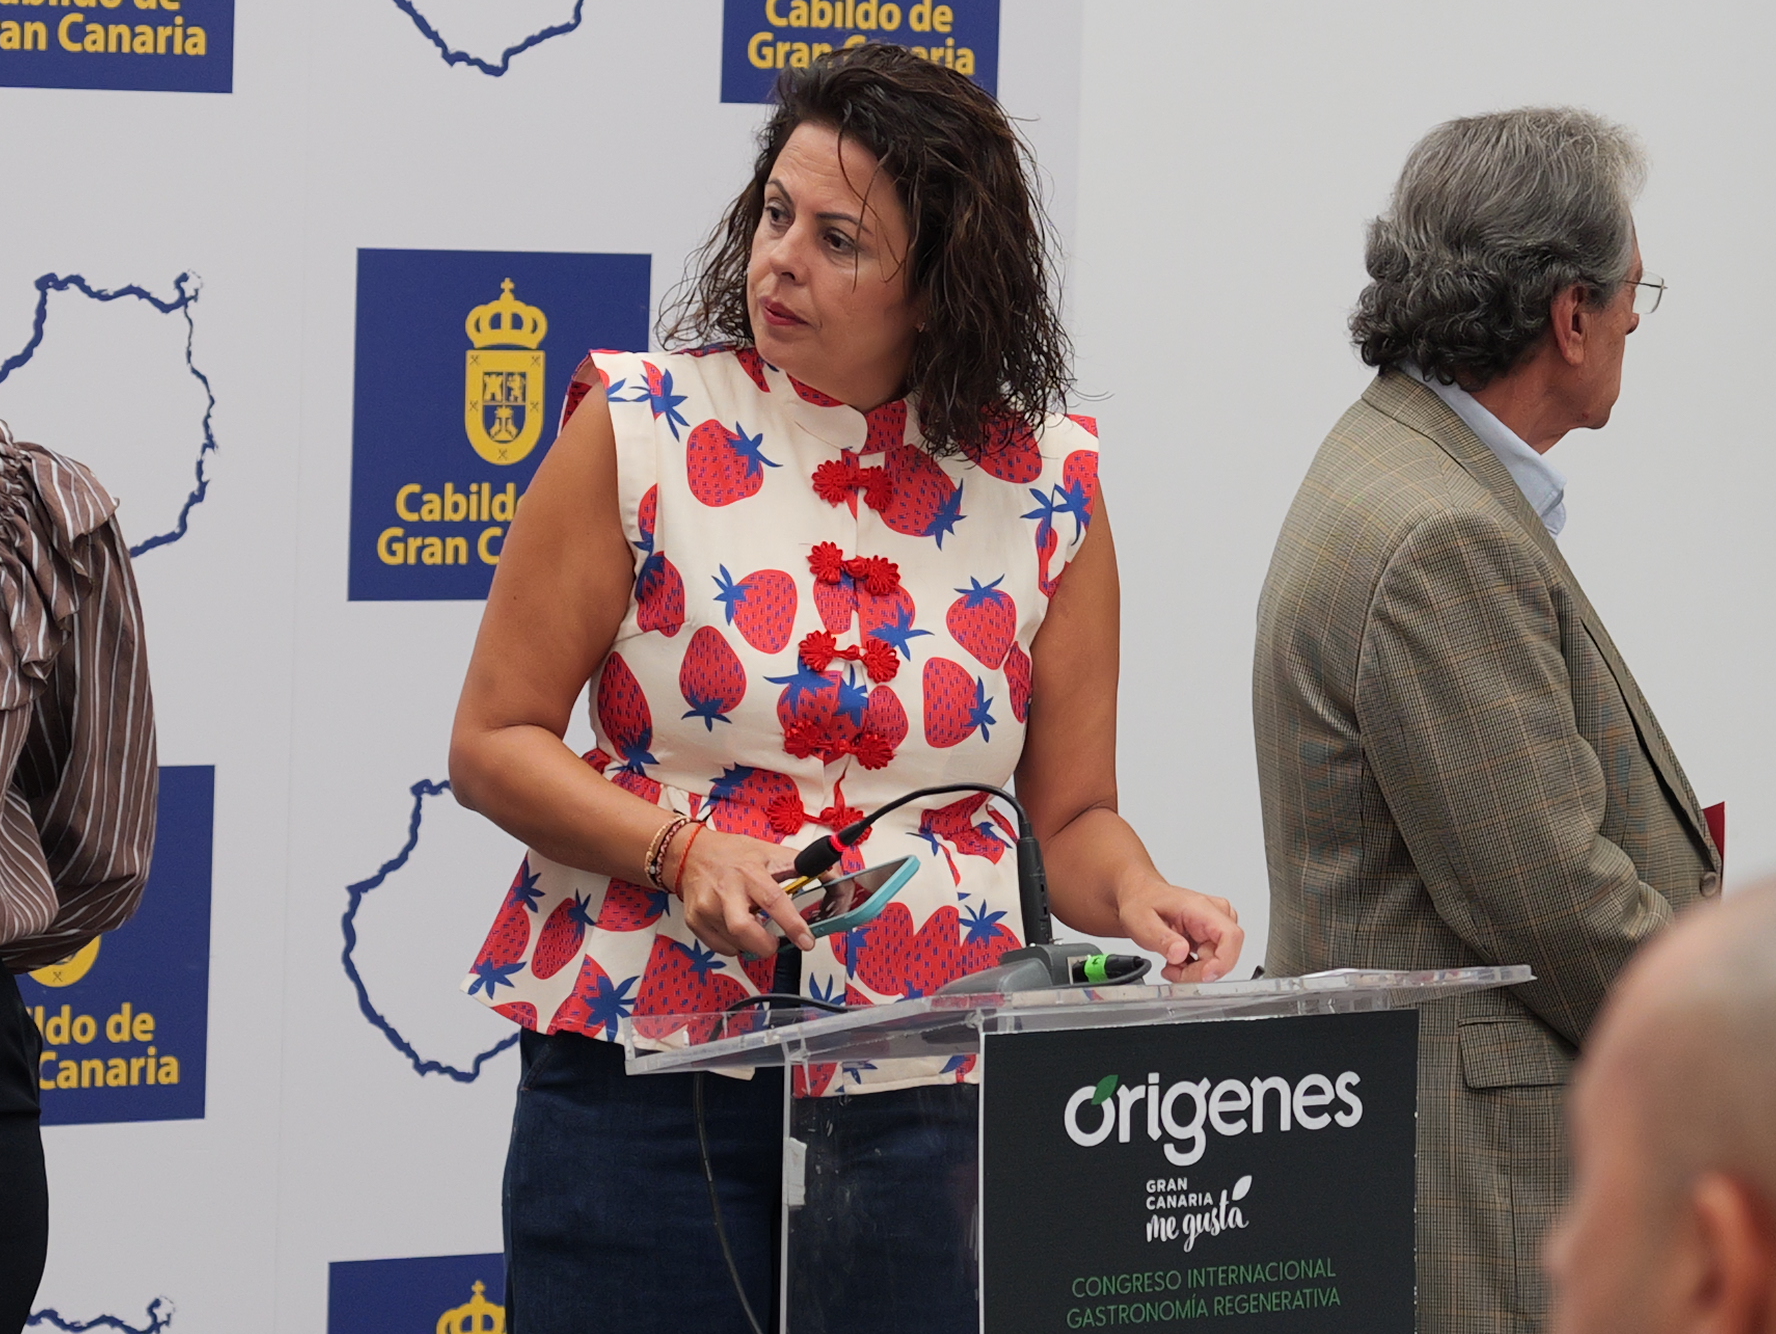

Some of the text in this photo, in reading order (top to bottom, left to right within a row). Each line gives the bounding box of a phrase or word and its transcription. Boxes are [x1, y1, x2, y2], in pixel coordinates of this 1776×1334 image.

[59, 14, 206, 55] Canaria
[395, 482, 524, 522] Cabild
[377, 526, 468, 565] Gran
[106, 1002, 156, 1043] de
[1146, 1177, 1188, 1193] GRAN
[1146, 1192, 1214, 1211] CANARIA
[1146, 1189, 1250, 1253] me gusta
[1072, 1257, 1336, 1298] CONGRESO INTERNACIONAL
[1066, 1286, 1341, 1329] GASTRONOMÍA REGENERATIVA
